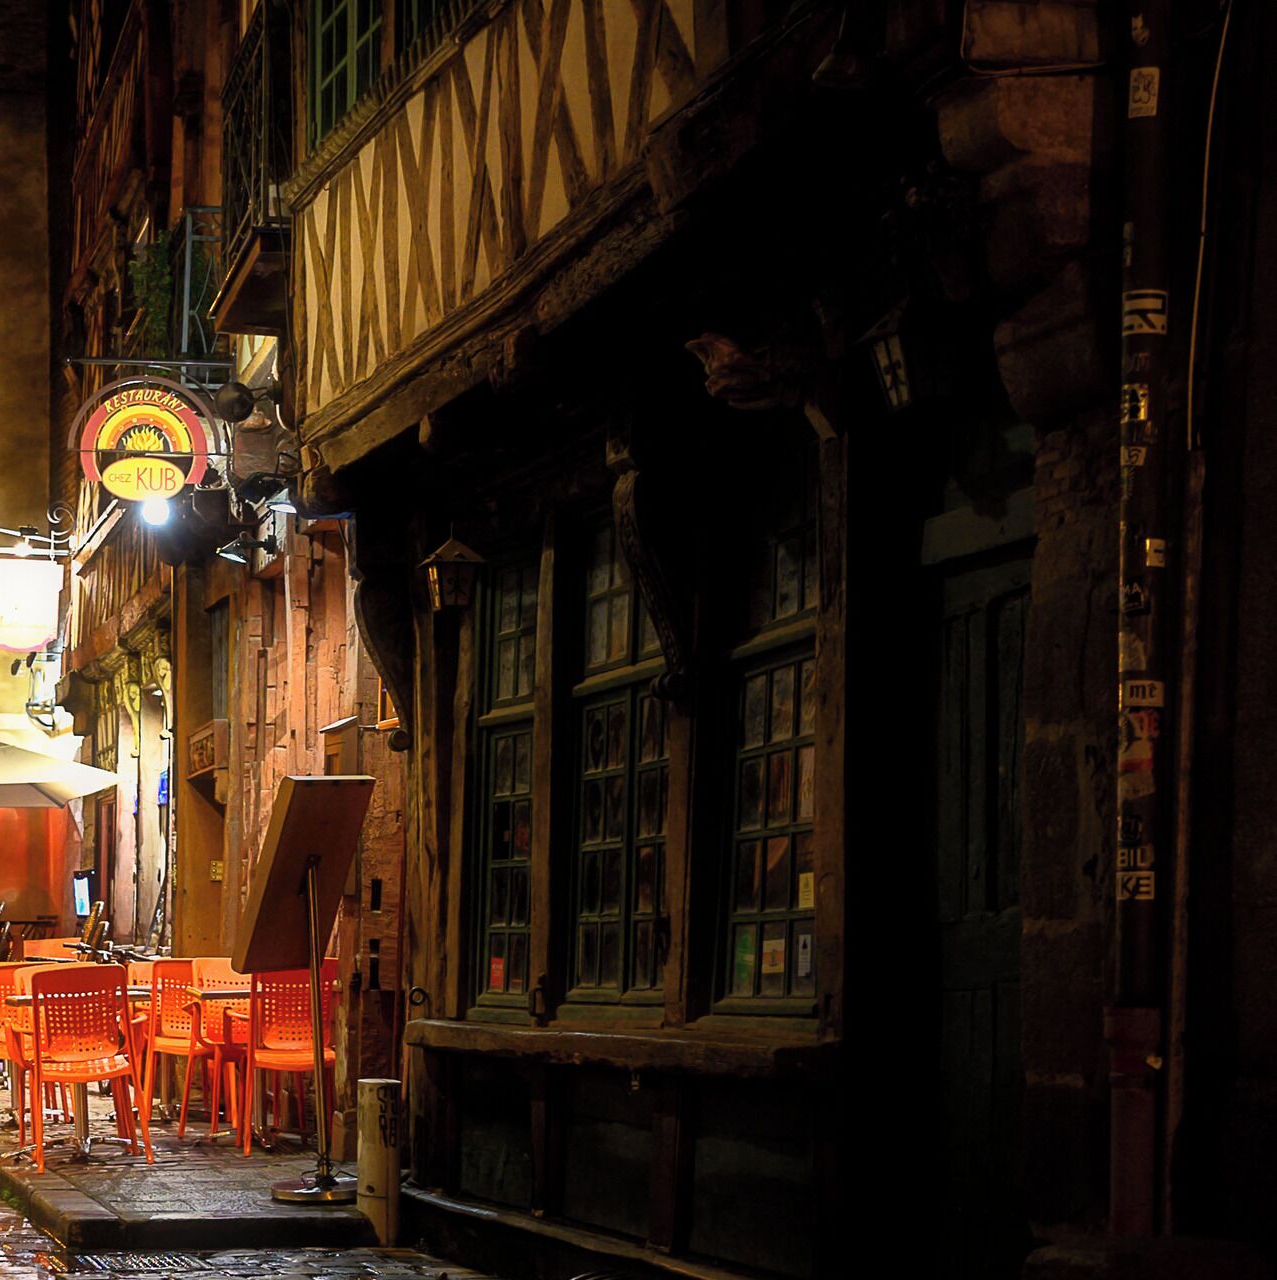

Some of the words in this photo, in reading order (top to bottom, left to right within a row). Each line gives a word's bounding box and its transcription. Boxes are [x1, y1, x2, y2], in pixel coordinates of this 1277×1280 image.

[103, 389, 188, 413] RESTAURANT
[108, 473, 132, 483] CHEZ
[136, 467, 176, 491] KUB
